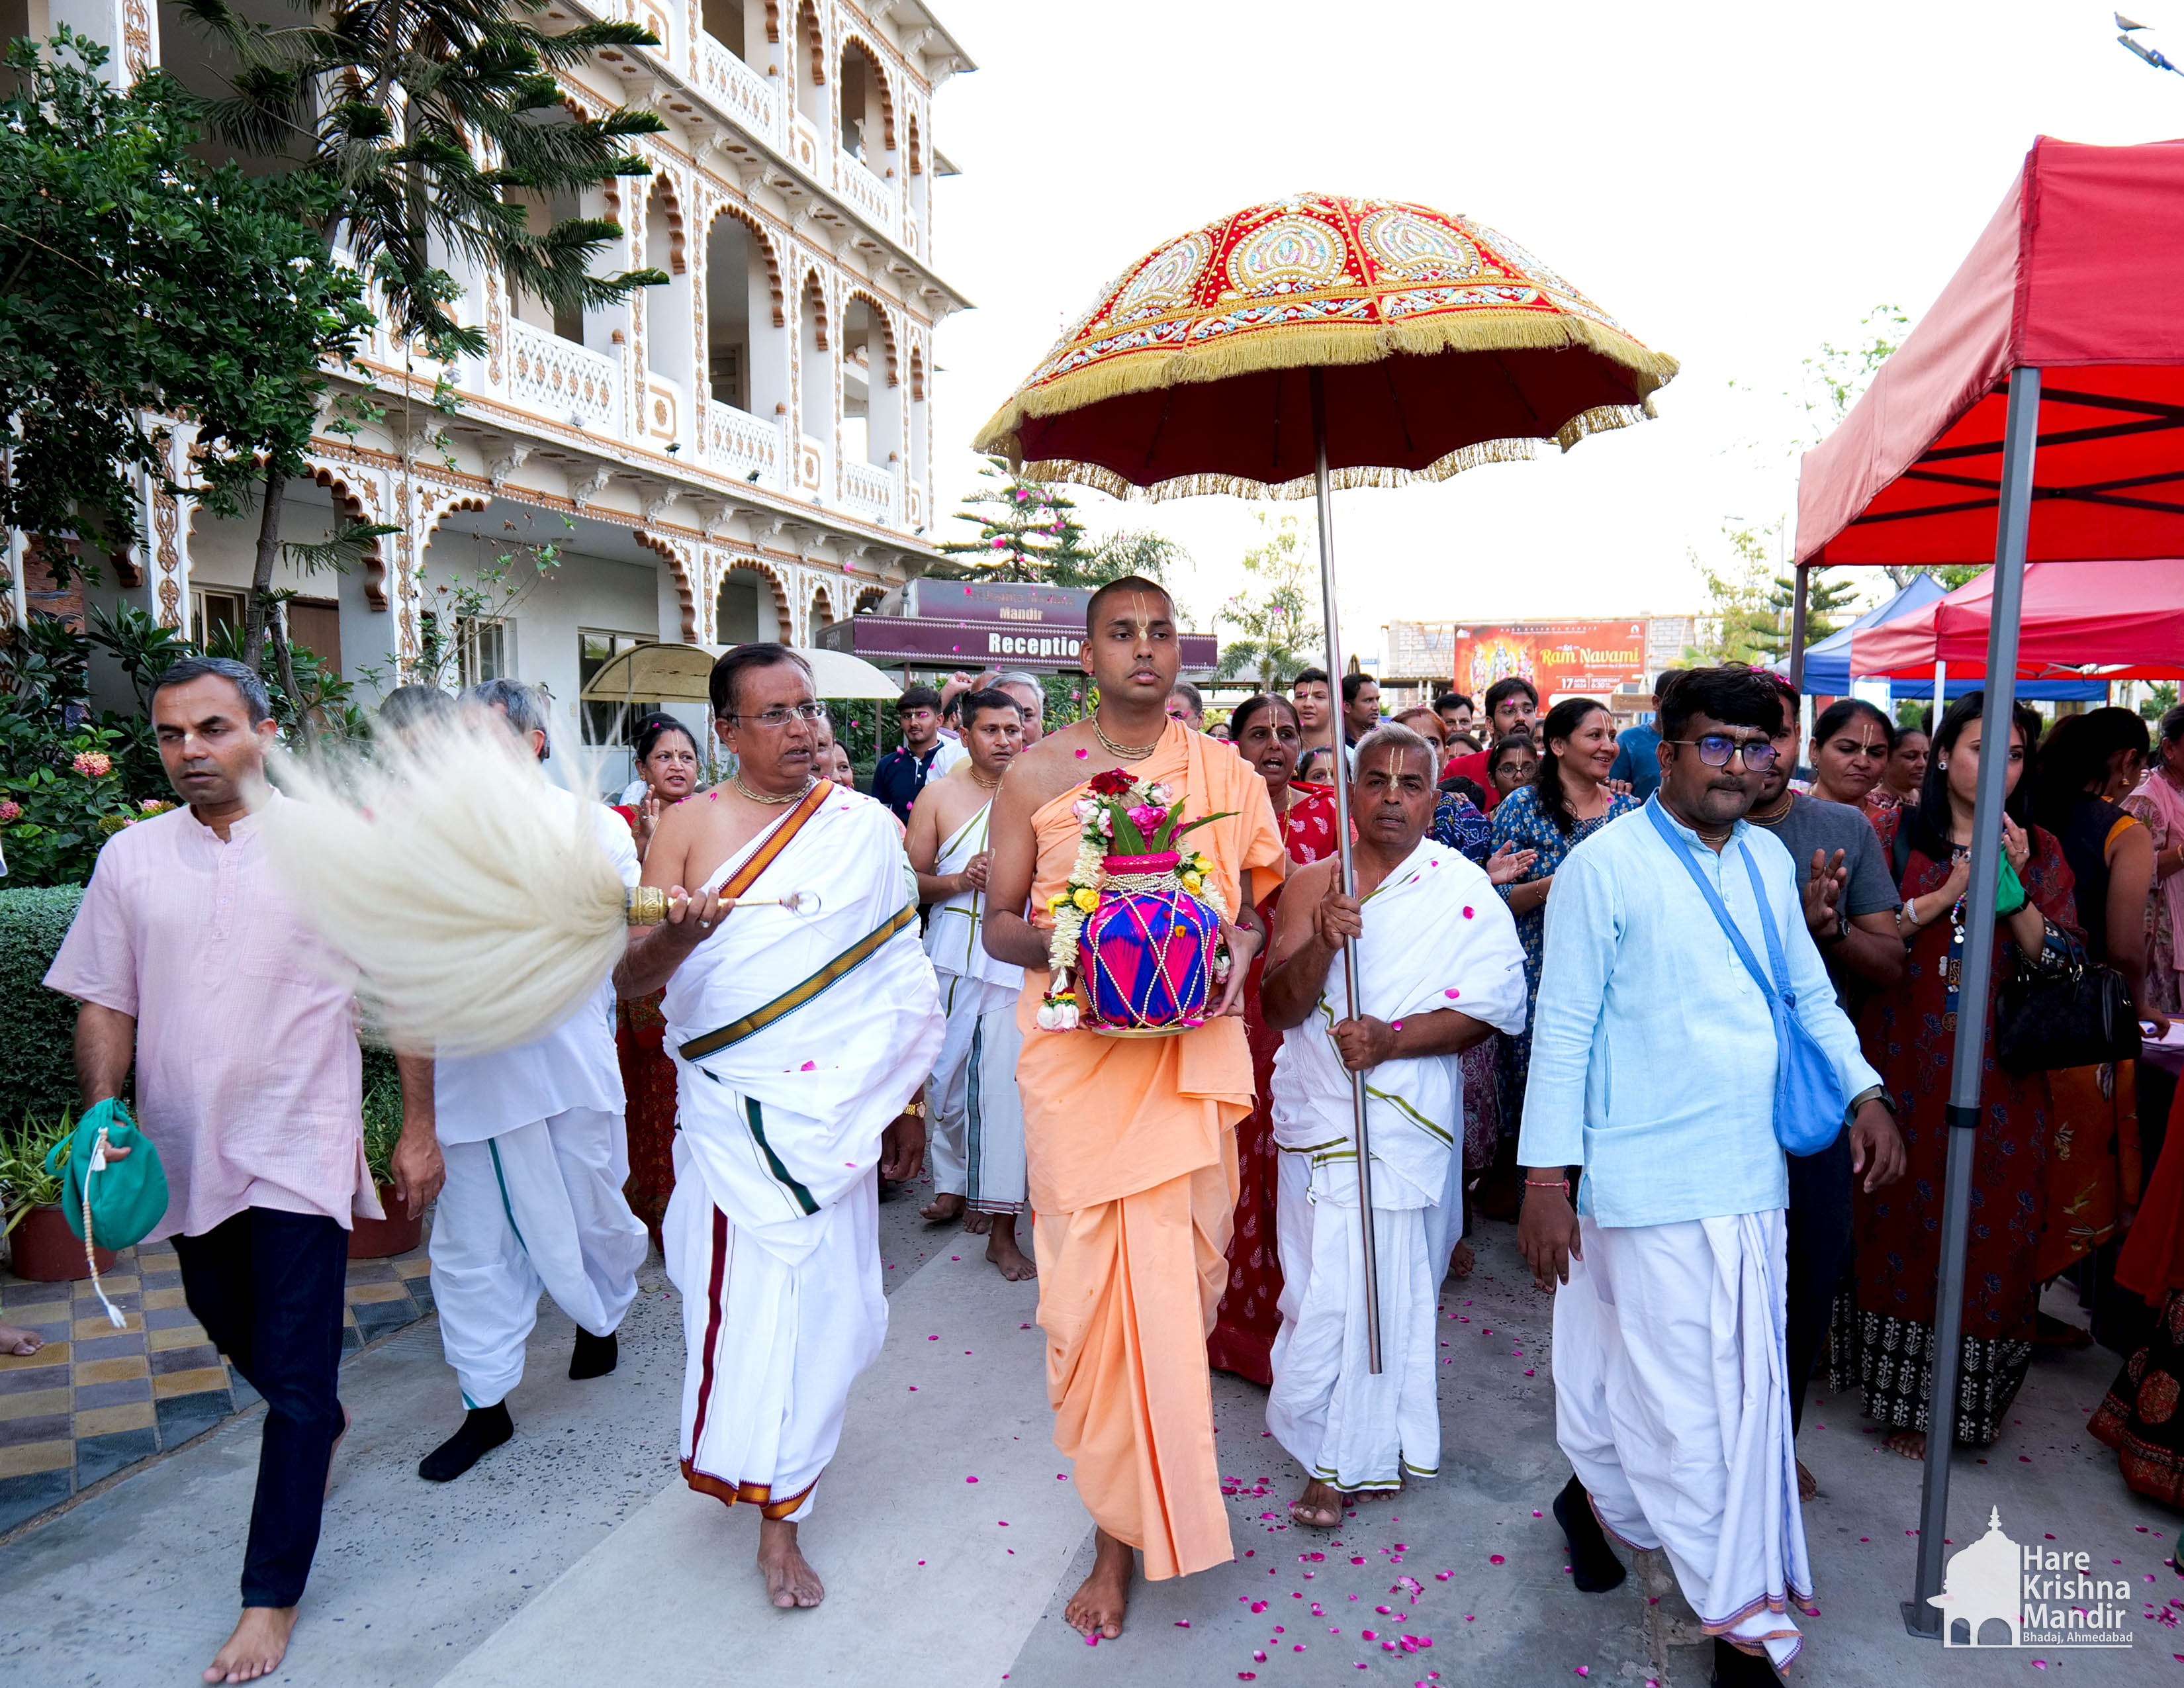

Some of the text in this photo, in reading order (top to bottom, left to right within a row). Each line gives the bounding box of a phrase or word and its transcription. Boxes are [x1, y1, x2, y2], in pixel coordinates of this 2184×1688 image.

[1000, 606, 1043, 621] Mandir
[989, 632, 1085, 657] Receptio
[1540, 647, 1641, 667] Ram Navami
[1562, 678, 1574, 689] 17
